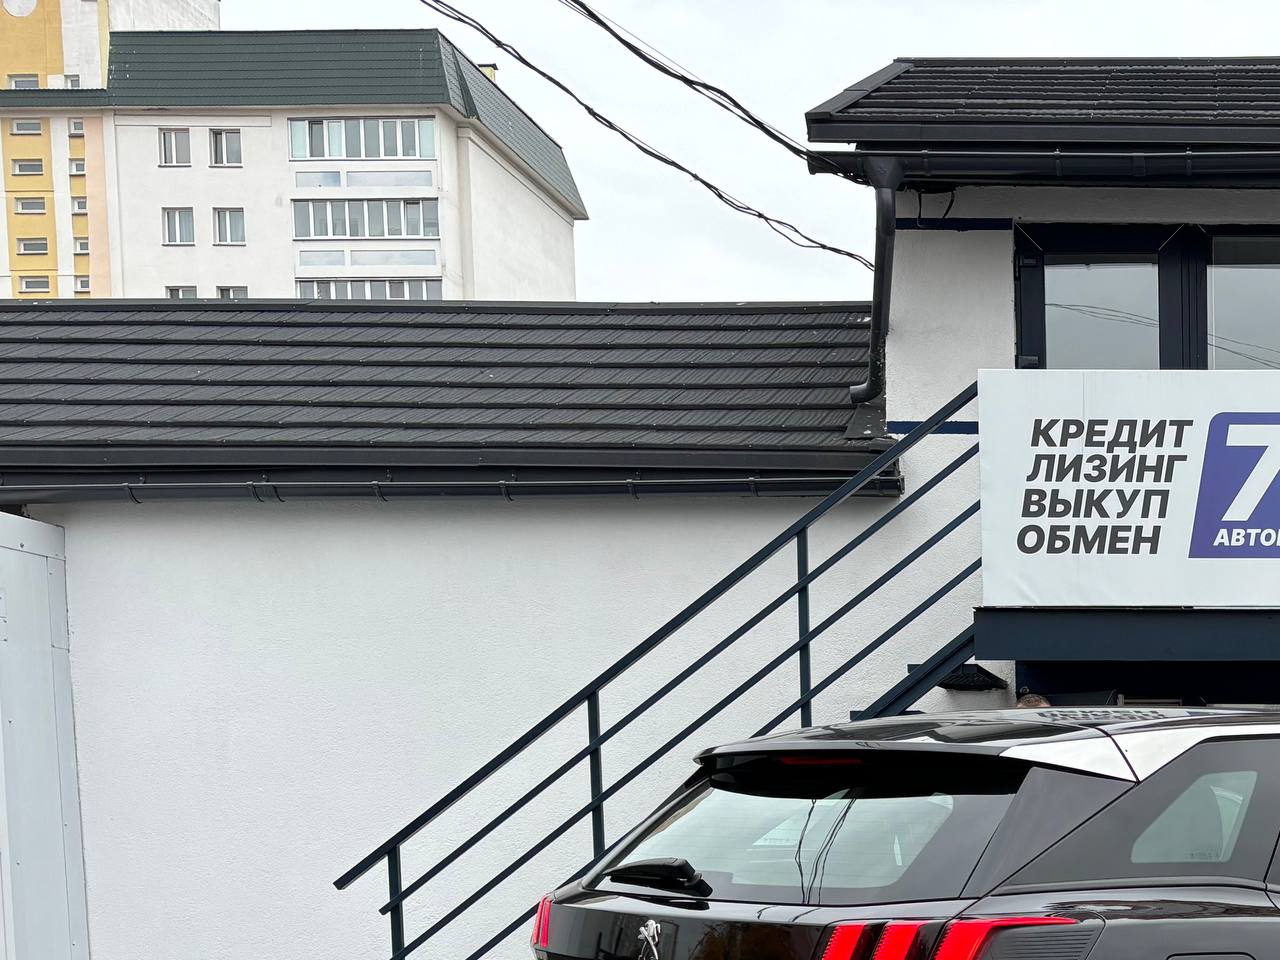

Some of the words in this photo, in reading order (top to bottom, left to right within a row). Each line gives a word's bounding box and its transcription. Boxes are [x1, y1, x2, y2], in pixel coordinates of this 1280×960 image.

[1030, 418, 1194, 453] КРЕДИТ
[1025, 453, 1188, 483] ЛИЗИНГ
[1021, 488, 1170, 519] ВЫКУП
[1016, 524, 1162, 555] ОБМЕН
